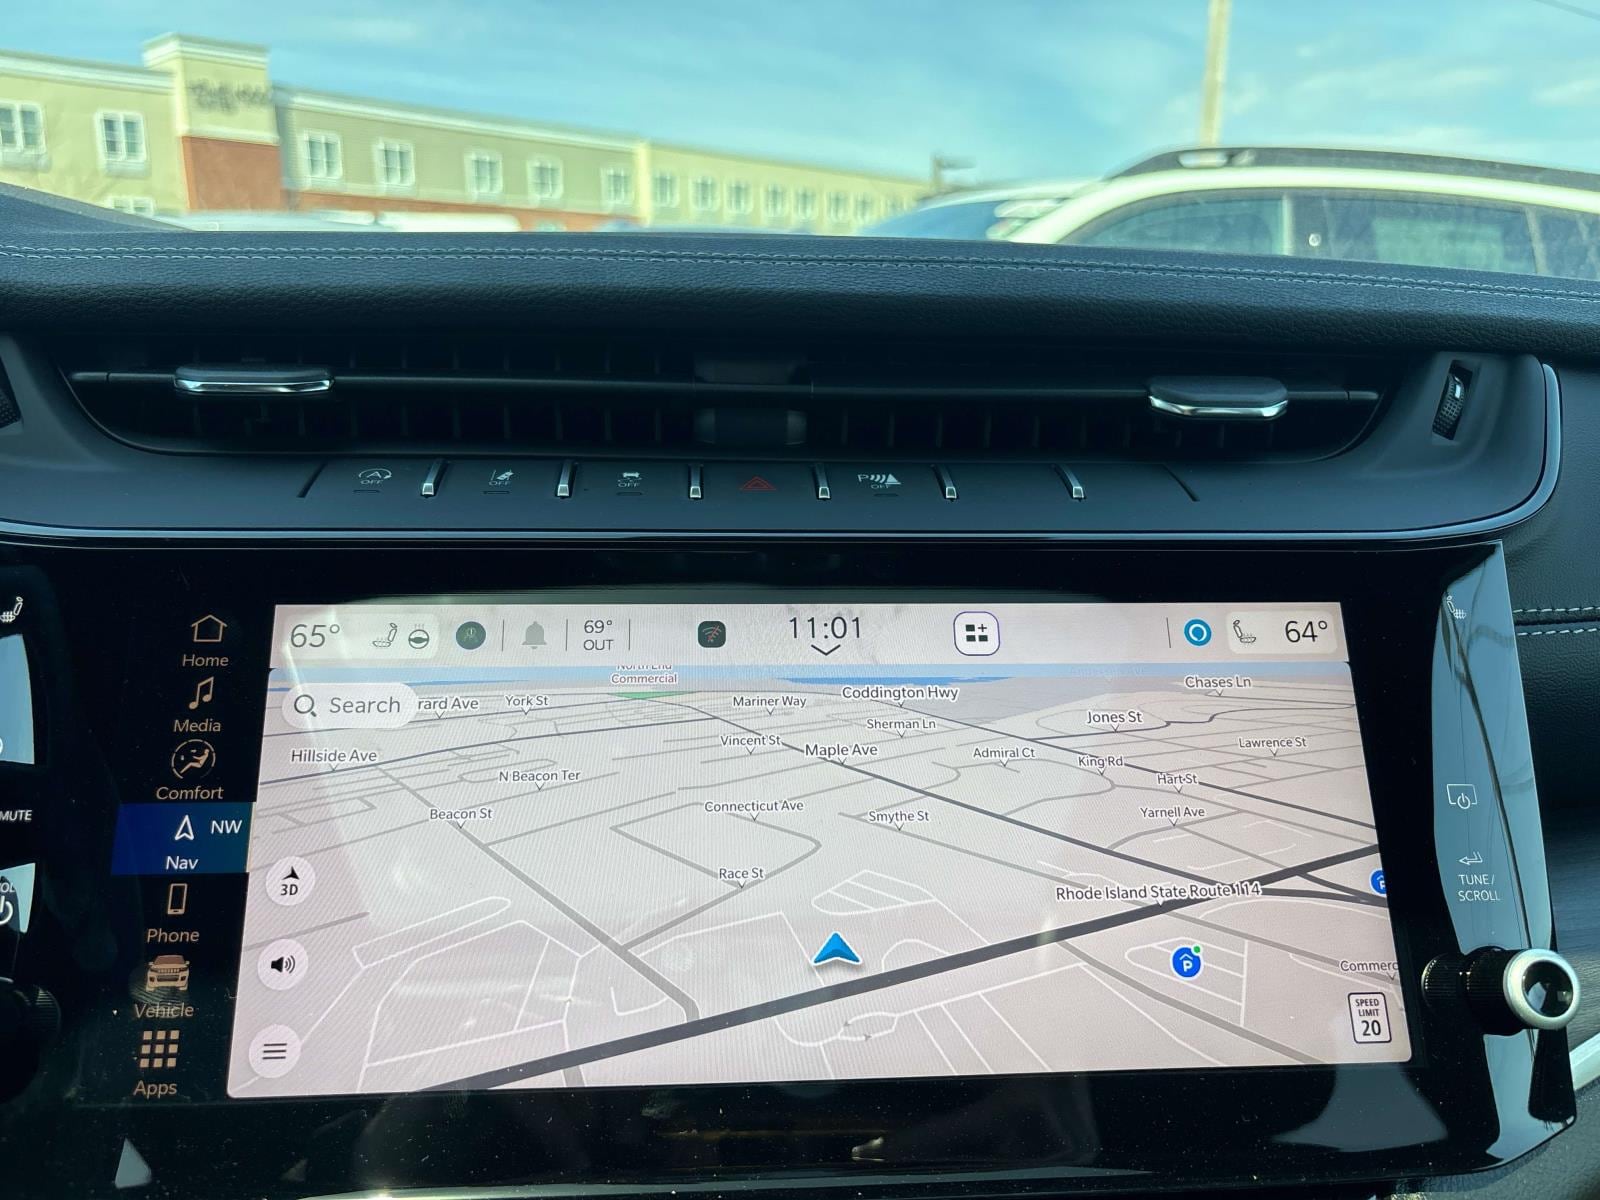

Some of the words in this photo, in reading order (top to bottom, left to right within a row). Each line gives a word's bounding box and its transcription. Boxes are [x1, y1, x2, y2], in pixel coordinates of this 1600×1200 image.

[583, 618, 613, 634] 69°
[789, 616, 862, 640] 11:01
[1284, 620, 1328, 643] 64°
[290, 622, 340, 648] 65°
[583, 638, 614, 652] OUT
[182, 653, 229, 668] Home
[611, 673, 677, 684] Commercial
[1185, 675, 1233, 688] Chases
[1235, 675, 1251, 688] Ln
[505, 696, 534, 707] York
[537, 695, 549, 706] St
[842, 686, 923, 704] Coddington
[927, 686, 959, 703] Hwy
[329, 697, 401, 714] Search
[452, 697, 479, 710] Ave
[733, 696, 779, 708] Mariner
[780, 696, 807, 710] Way
[867, 718, 917, 729] Sherman
[921, 718, 936, 729] Ln
[1087, 711, 1126, 724] Jones
[1128, 710, 1142, 722] St
[173, 718, 221, 733] Media
[720, 735, 765, 746] Vincent
[767, 735, 781, 746] St
[1239, 737, 1292, 748] Lawrence
[1294, 736, 1307, 747] St
[291, 749, 345, 762] Hillside
[349, 749, 377, 762] Ave
[805, 744, 849, 759] Maple
[851, 743, 878, 756] Ave
[973, 747, 1022, 759] Admiral
[1024, 747, 1035, 758] Ct
[1078, 756, 1104, 769] King
[1107, 756, 1123, 767] Rd
[499, 771, 509, 782] N
[512, 771, 558, 782] Beacon
[561, 770, 580, 781] Ter
[1157, 773, 1182, 784] Hart
[1184, 773, 1197, 784] St
[156, 785, 224, 801] Comfort
[704, 801, 777, 813] Connecticut
[780, 800, 804, 812] Ave
[1140, 807, 1181, 818] Yarnell
[1183, 806, 1205, 817] Ave
[0, 810, 32, 821] MUTE
[430, 808, 477, 820] Beacon
[480, 808, 492, 820] St
[868, 811, 914, 825] Smythe
[918, 810, 929, 822] St
[210, 820, 242, 834] NW
[165, 856, 198, 870] Nav
[719, 867, 749, 879] Race
[750, 867, 764, 879] St
[1458, 874, 1495, 886] TUNE/
[280, 884, 298, 896] 3D
[1056, 887, 1102, 900] Rhode
[1105, 885, 1148, 899] Island
[1151, 885, 1187, 898] State
[1190, 885, 1230, 898] Route
[1232, 883, 1261, 897] 114
[1458, 890, 1500, 902] SCROLL
[147, 929, 200, 943] Phone
[1355, 998, 1380, 1007] SPEED
[133, 1003, 194, 1018] Vehicle
[1358, 1008, 1380, 1017] LIMIT
[1361, 1019, 1382, 1037] 20
[133, 1080, 178, 1099] Apps
